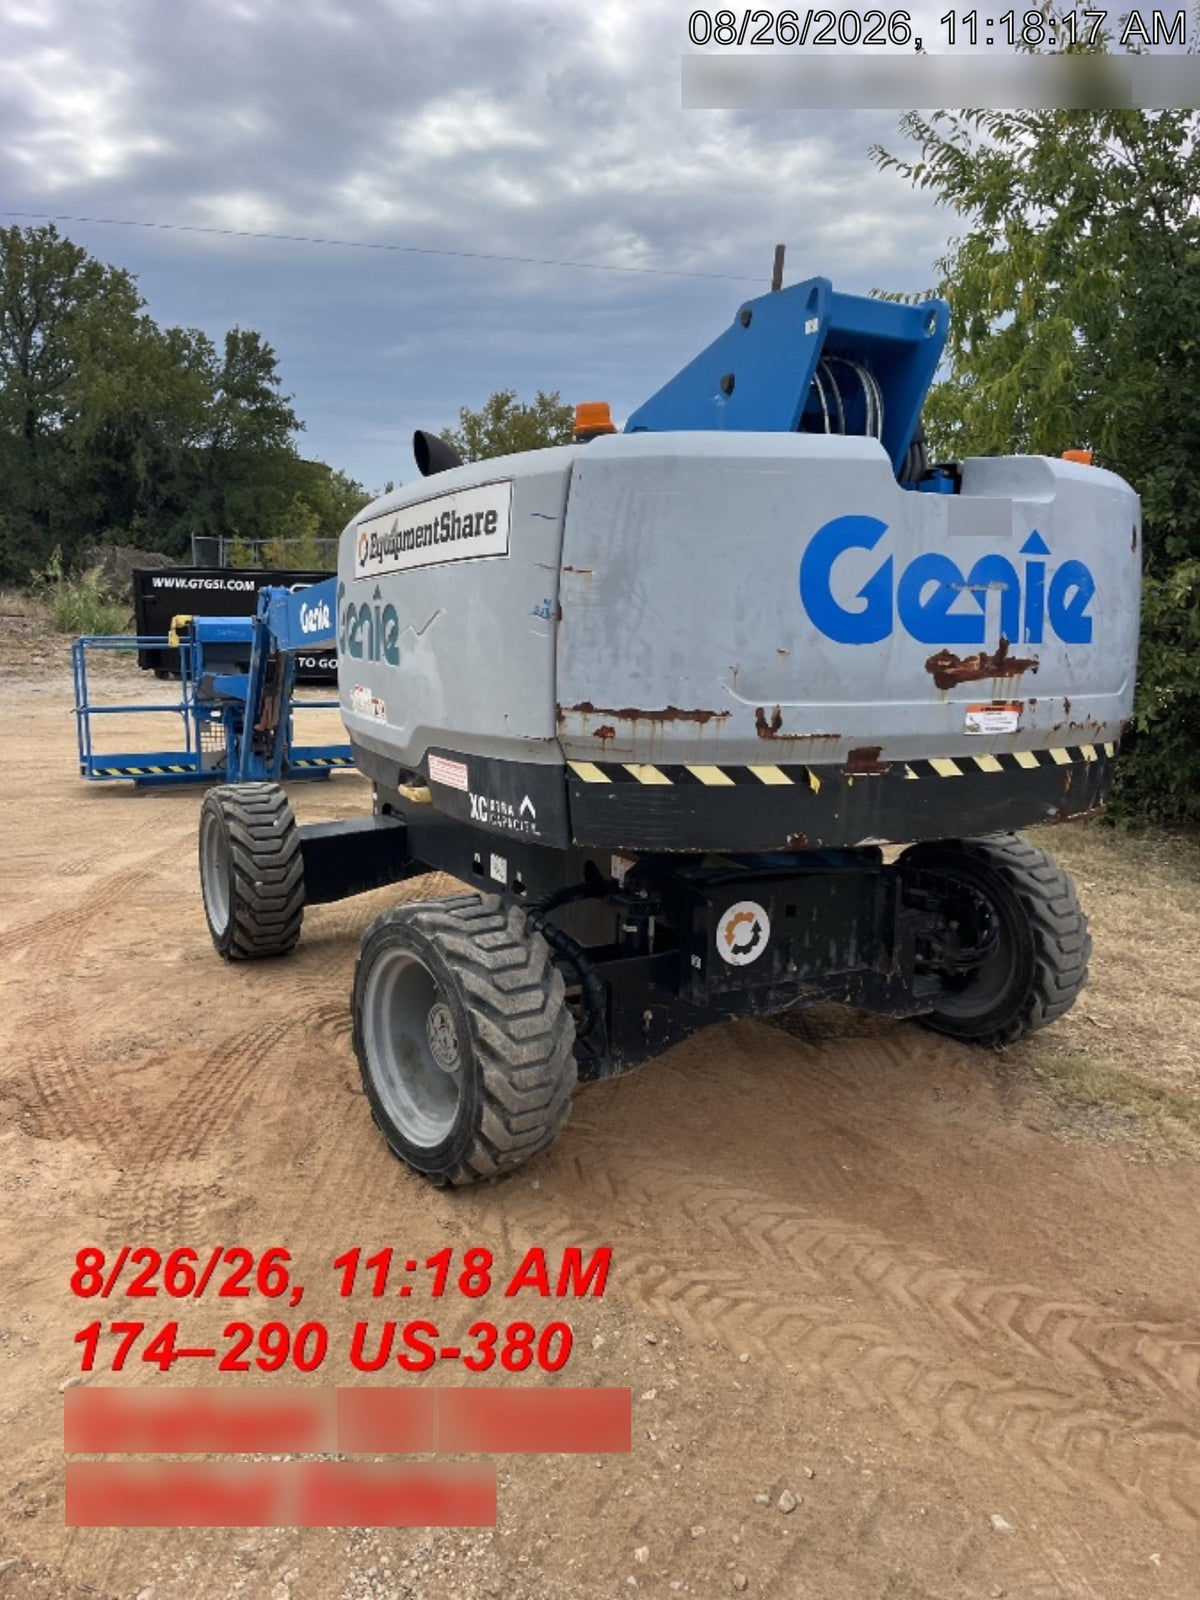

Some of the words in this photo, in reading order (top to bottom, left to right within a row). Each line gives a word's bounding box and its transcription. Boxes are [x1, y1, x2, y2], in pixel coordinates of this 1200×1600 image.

[152, 577, 255, 591] WWW.GTGSI.COM
[799, 514, 1095, 644] Genie
[300, 600, 330, 633] Genie
[298, 657, 316, 668] TO
[468, 792, 488, 822] XC
